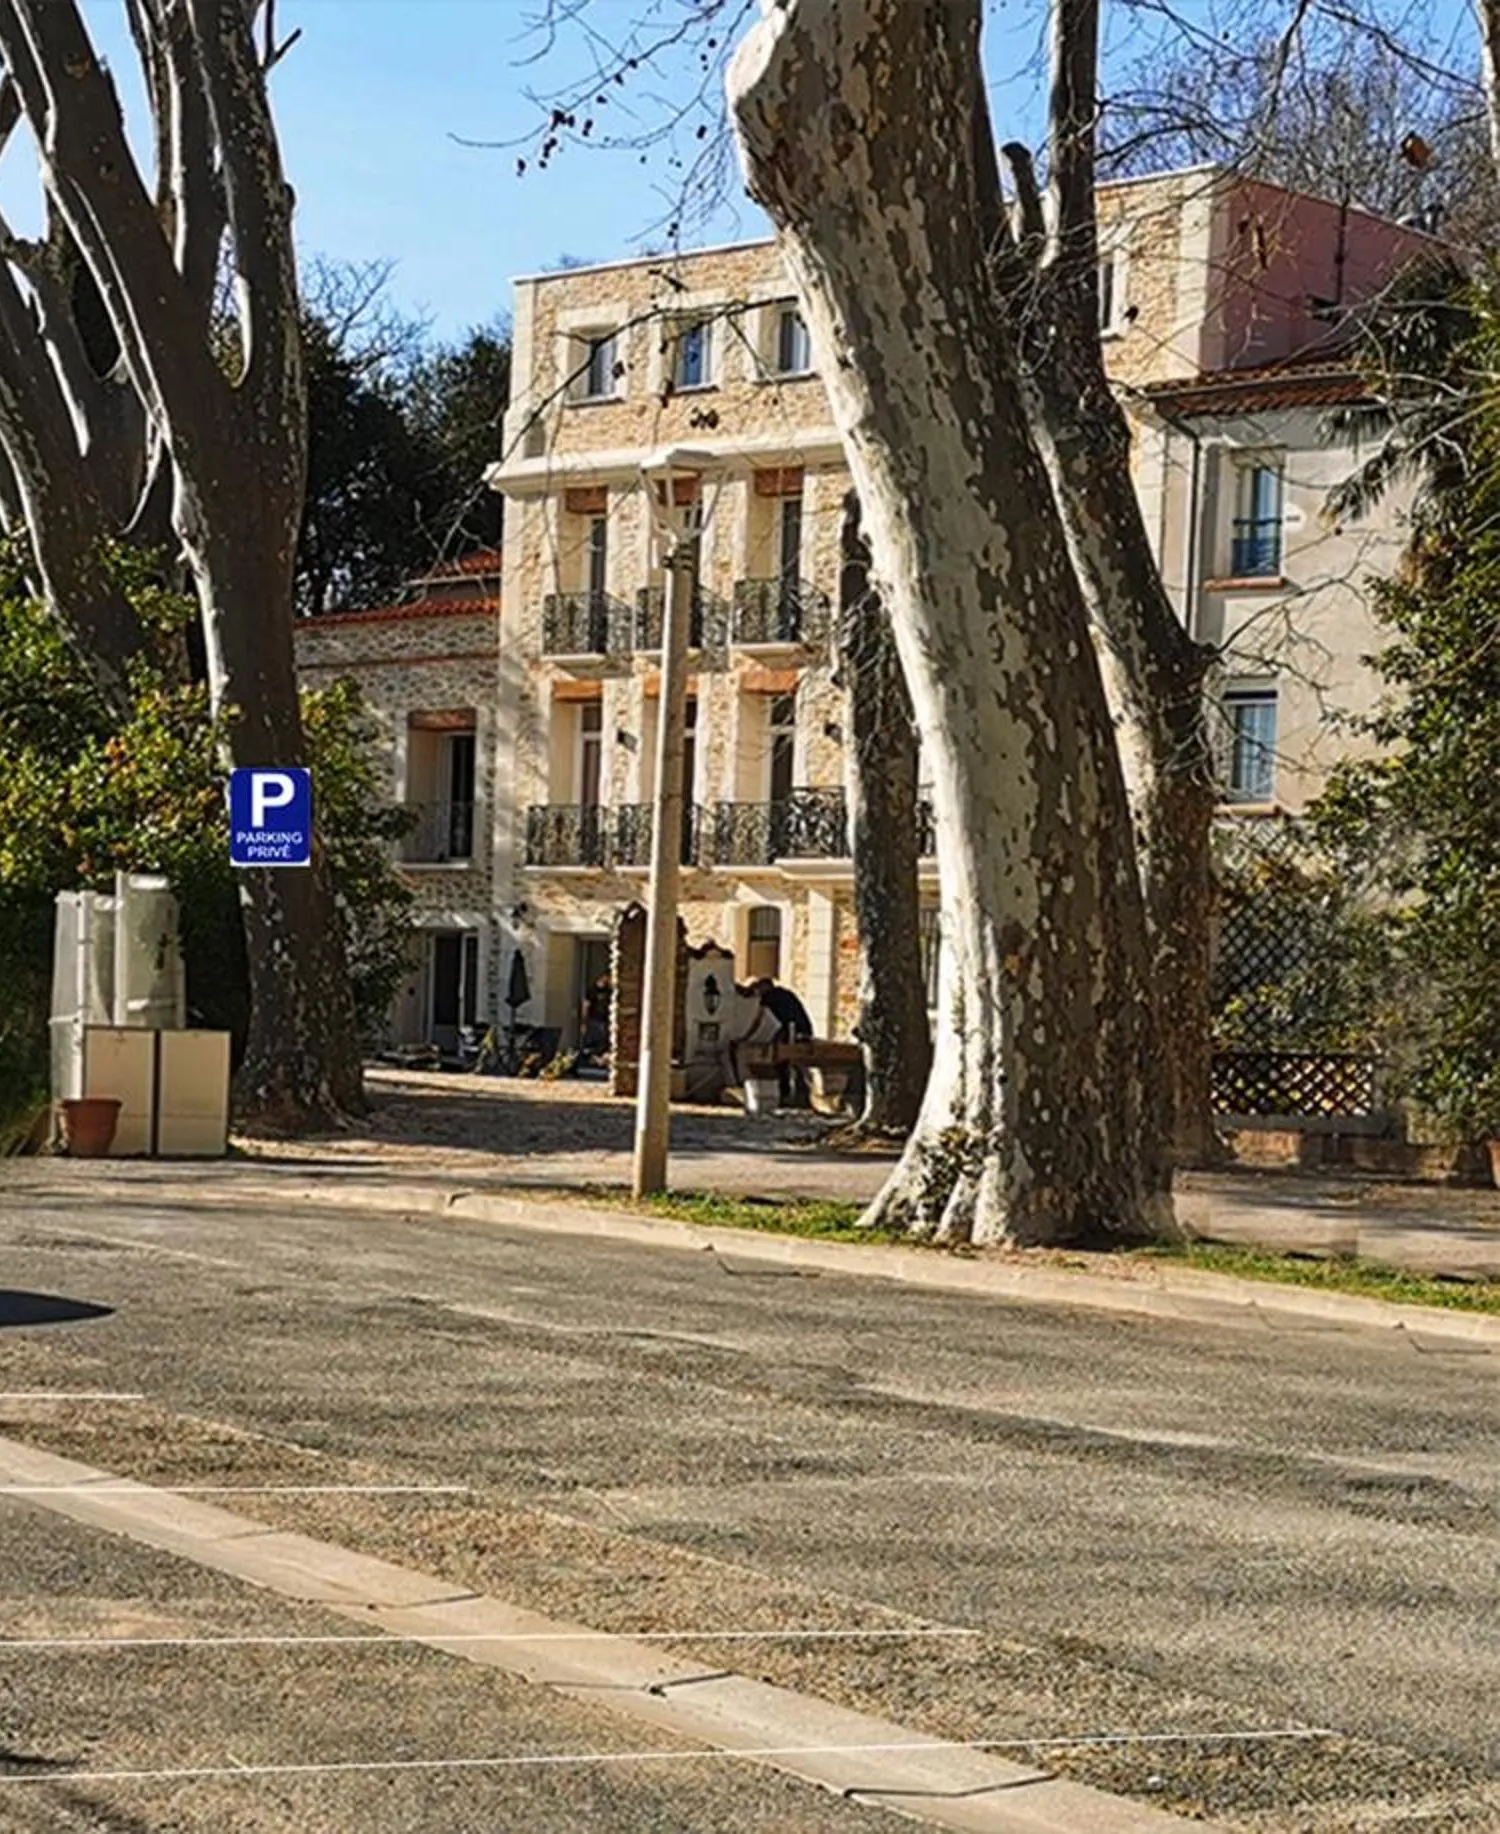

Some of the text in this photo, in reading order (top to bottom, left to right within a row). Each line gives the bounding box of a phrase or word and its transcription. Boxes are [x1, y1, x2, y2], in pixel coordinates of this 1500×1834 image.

[251, 773, 295, 828] P
[236, 832, 303, 844] PARKING
[248, 845, 291, 858] PRIVÉ
